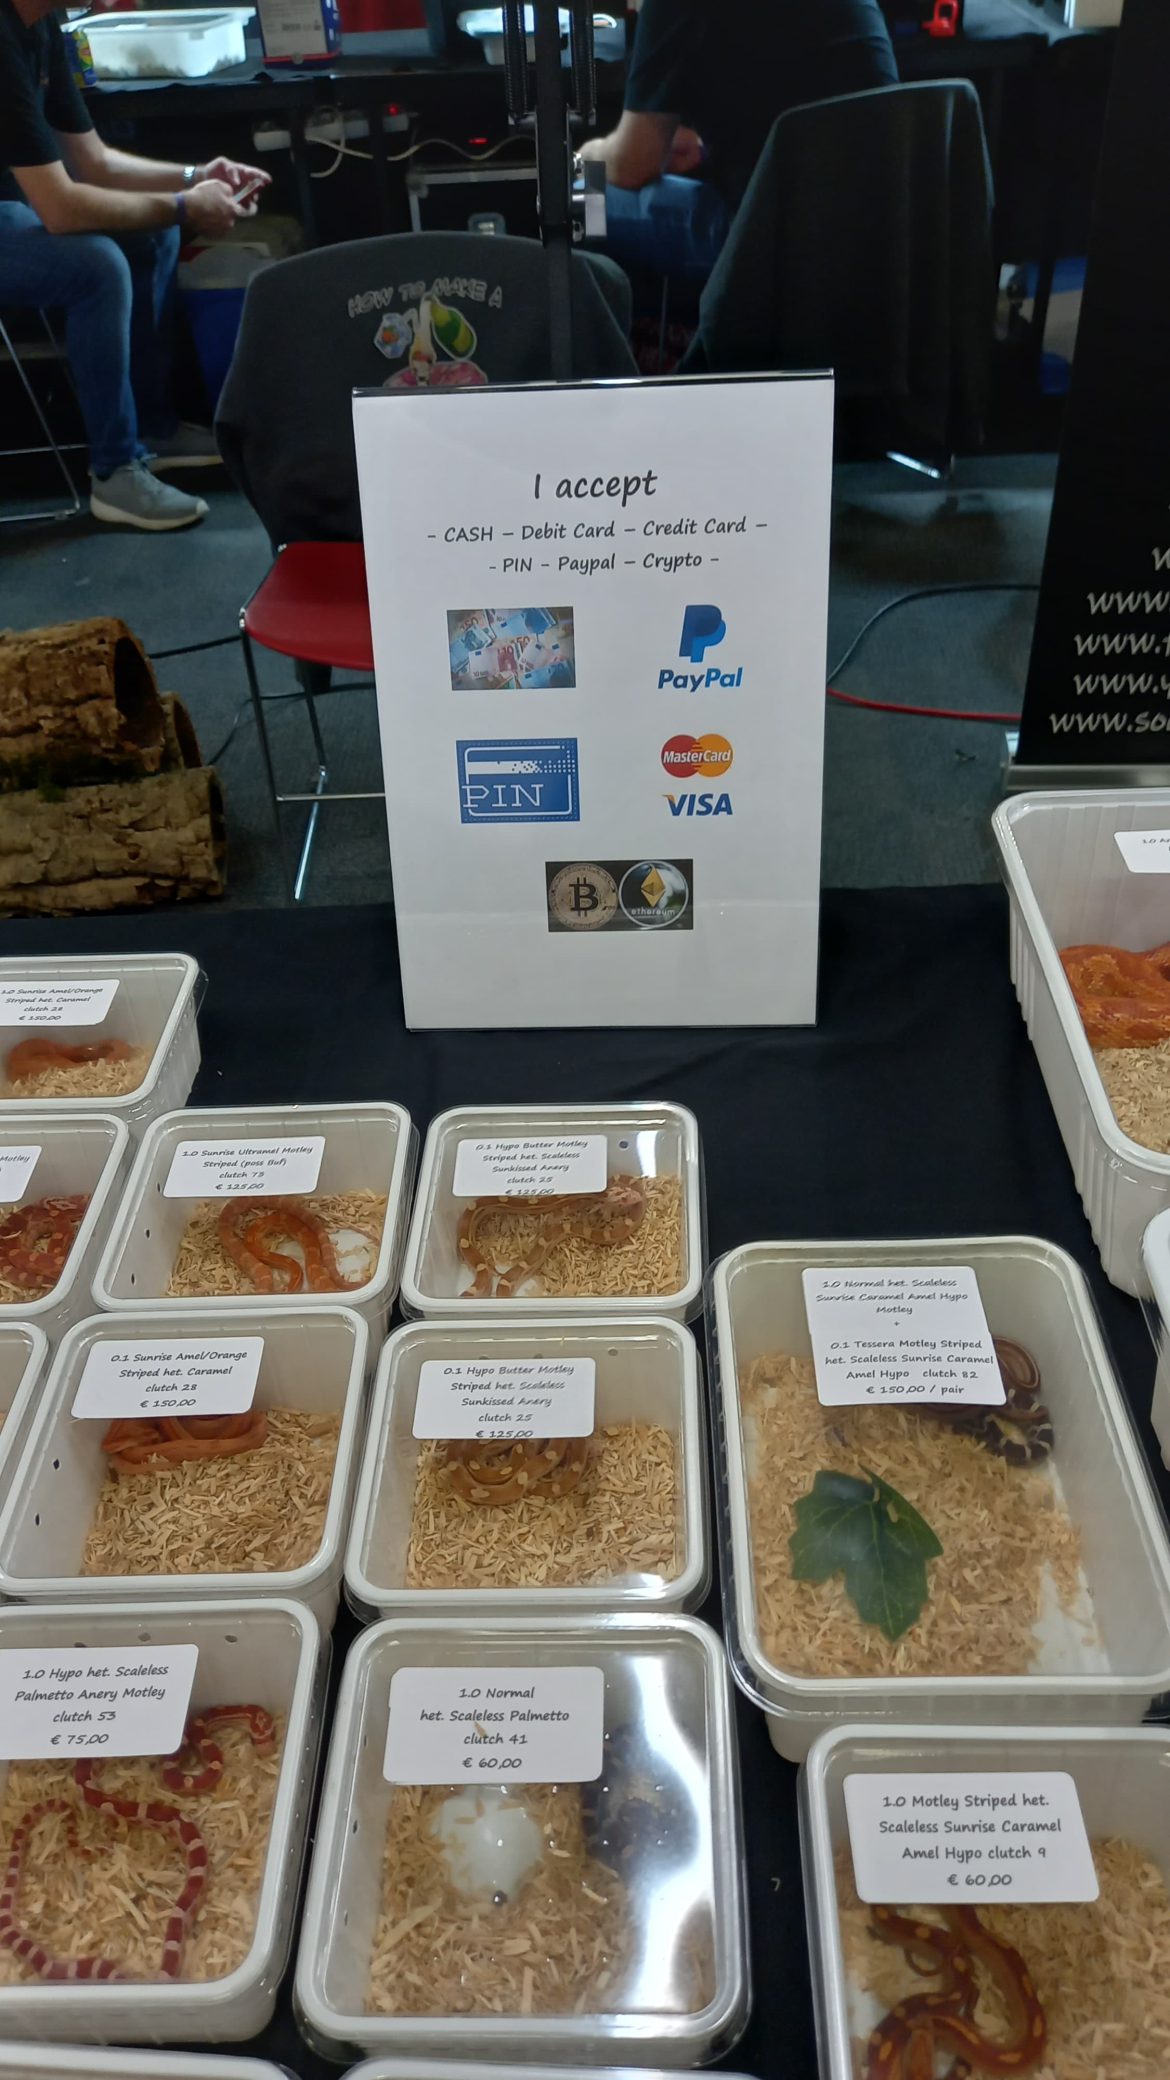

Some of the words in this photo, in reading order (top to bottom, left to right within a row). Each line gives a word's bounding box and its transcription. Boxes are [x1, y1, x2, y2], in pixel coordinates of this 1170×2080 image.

[488, 286, 502, 308] A
[534, 473, 541, 499] I
[555, 470, 658, 507] accept
[444, 525, 493, 542] CASH
[522, 522, 567, 540] Debit
[573, 521, 615, 539] Card
[643, 518, 697, 536] Credit
[704, 516, 746, 534] Card
[503, 557, 533, 572] PIN
[558, 553, 615, 576] Paypal
[643, 553, 702, 573] Crypto
[658, 667, 743, 692] PayPal
[1050, 711, 1170, 734] www.so
[663, 750, 731, 764] MasterCard
[461, 784, 544, 807] PIN
[661, 793, 733, 816] VISA
[496, 1143, 519, 1151] Hypo
[556, 1140, 588, 1148] Motley
[201, 1149, 234, 1157] Sunrise
[483, 1154, 517, 1162] Striped
[203, 1161, 237, 1169] Striped
[240, 1160, 264, 1168] (poss
[517, 1188, 555, 1196] 125,00
[844, 1279, 885, 1288] Normal
[911, 1278, 957, 1287] Scaleless
[816, 1293, 855, 1301] Sunrise
[859, 1293, 904, 1301] Caramel
[940, 1293, 968, 1302] Hypo
[876, 1306, 913, 1314] Motley
[854, 1340, 895, 1348] Tessera
[899, 1340, 936, 1349] Motley
[940, 1340, 982, 1351] Striped
[111, 1354, 129, 1362] 0.1
[133, 1353, 172, 1362] Sunrise
[176, 1351, 247, 1361] Amel/Orange
[825, 1357, 846, 1365] het.
[850, 1355, 897, 1364] Scaleless
[902, 1355, 943, 1363] Sunrise
[947, 1355, 994, 1364] Caramel
[119, 1369, 160, 1379] Striped
[163, 1368, 183, 1376] het.
[187, 1366, 233, 1376] Caramel
[466, 1367, 495, 1376] Hypo
[499, 1366, 534, 1374] Butter
[538, 1365, 575, 1375] Motley
[846, 1370, 876, 1379] Amel
[880, 1370, 910, 1380] Hypo
[923, 1369, 957, 1378] clutch
[962, 1371, 979, 1379] 82
[145, 1384, 178, 1393] clutch
[181, 1384, 198, 1392] 28
[451, 1382, 491, 1392] Striped
[495, 1382, 515, 1390] het.
[519, 1381, 566, 1390] Scaleless
[880, 1385, 926, 1394] 150,00
[941, 1386, 965, 1395] pair
[140, 1400, 149, 1408] €
[152, 1399, 196, 1408] 150,00
[462, 1397, 514, 1406] Sunkissed
[478, 1413, 512, 1422] clutch
[516, 1414, 533, 1422] 25
[476, 1430, 484, 1438] €
[489, 1430, 534, 1439] 125,00
[22, 1669, 45, 1680] 1.0
[49, 1668, 82, 1682] Hypo
[86, 1666, 110, 1678] het.
[115, 1664, 169, 1677] Scaleless
[15, 1689, 74, 1701] Palmetto
[77, 1689, 118, 1702] Anery
[122, 1686, 166, 1699] Motley
[459, 1688, 481, 1698] 1.0
[486, 1687, 536, 1699] Normal
[53, 1710, 92, 1723] clutch
[97, 1711, 116, 1721] 53
[420, 1710, 444, 1721] het.
[450, 1709, 505, 1721] Scaleless
[509, 1710, 570, 1721] Palmetto
[50, 1735, 60, 1745] €
[68, 1734, 110, 1745] 75,00
[464, 1733, 504, 1745] clutch
[509, 1734, 528, 1745] 41
[463, 1757, 472, 1768] €
[479, 1758, 522, 1769] 60,00
[883, 1796, 907, 1807] 1.0
[912, 1794, 959, 1811] Motley
[964, 1794, 1017, 1811] Striped
[1023, 1793, 1049, 1806] het.
[879, 1820, 939, 1833] Scaleless
[944, 1820, 995, 1833] Sunrise
[1002, 1818, 1062, 1832] Caramel
[902, 1846, 939, 1859] Amel
[945, 1847, 982, 1863] Hypo
[988, 1845, 1031, 1858] clutch
[1038, 1847, 1047, 1858] 9
[947, 1874, 958, 1886] €
[965, 1874, 1012, 1887] 60,00
